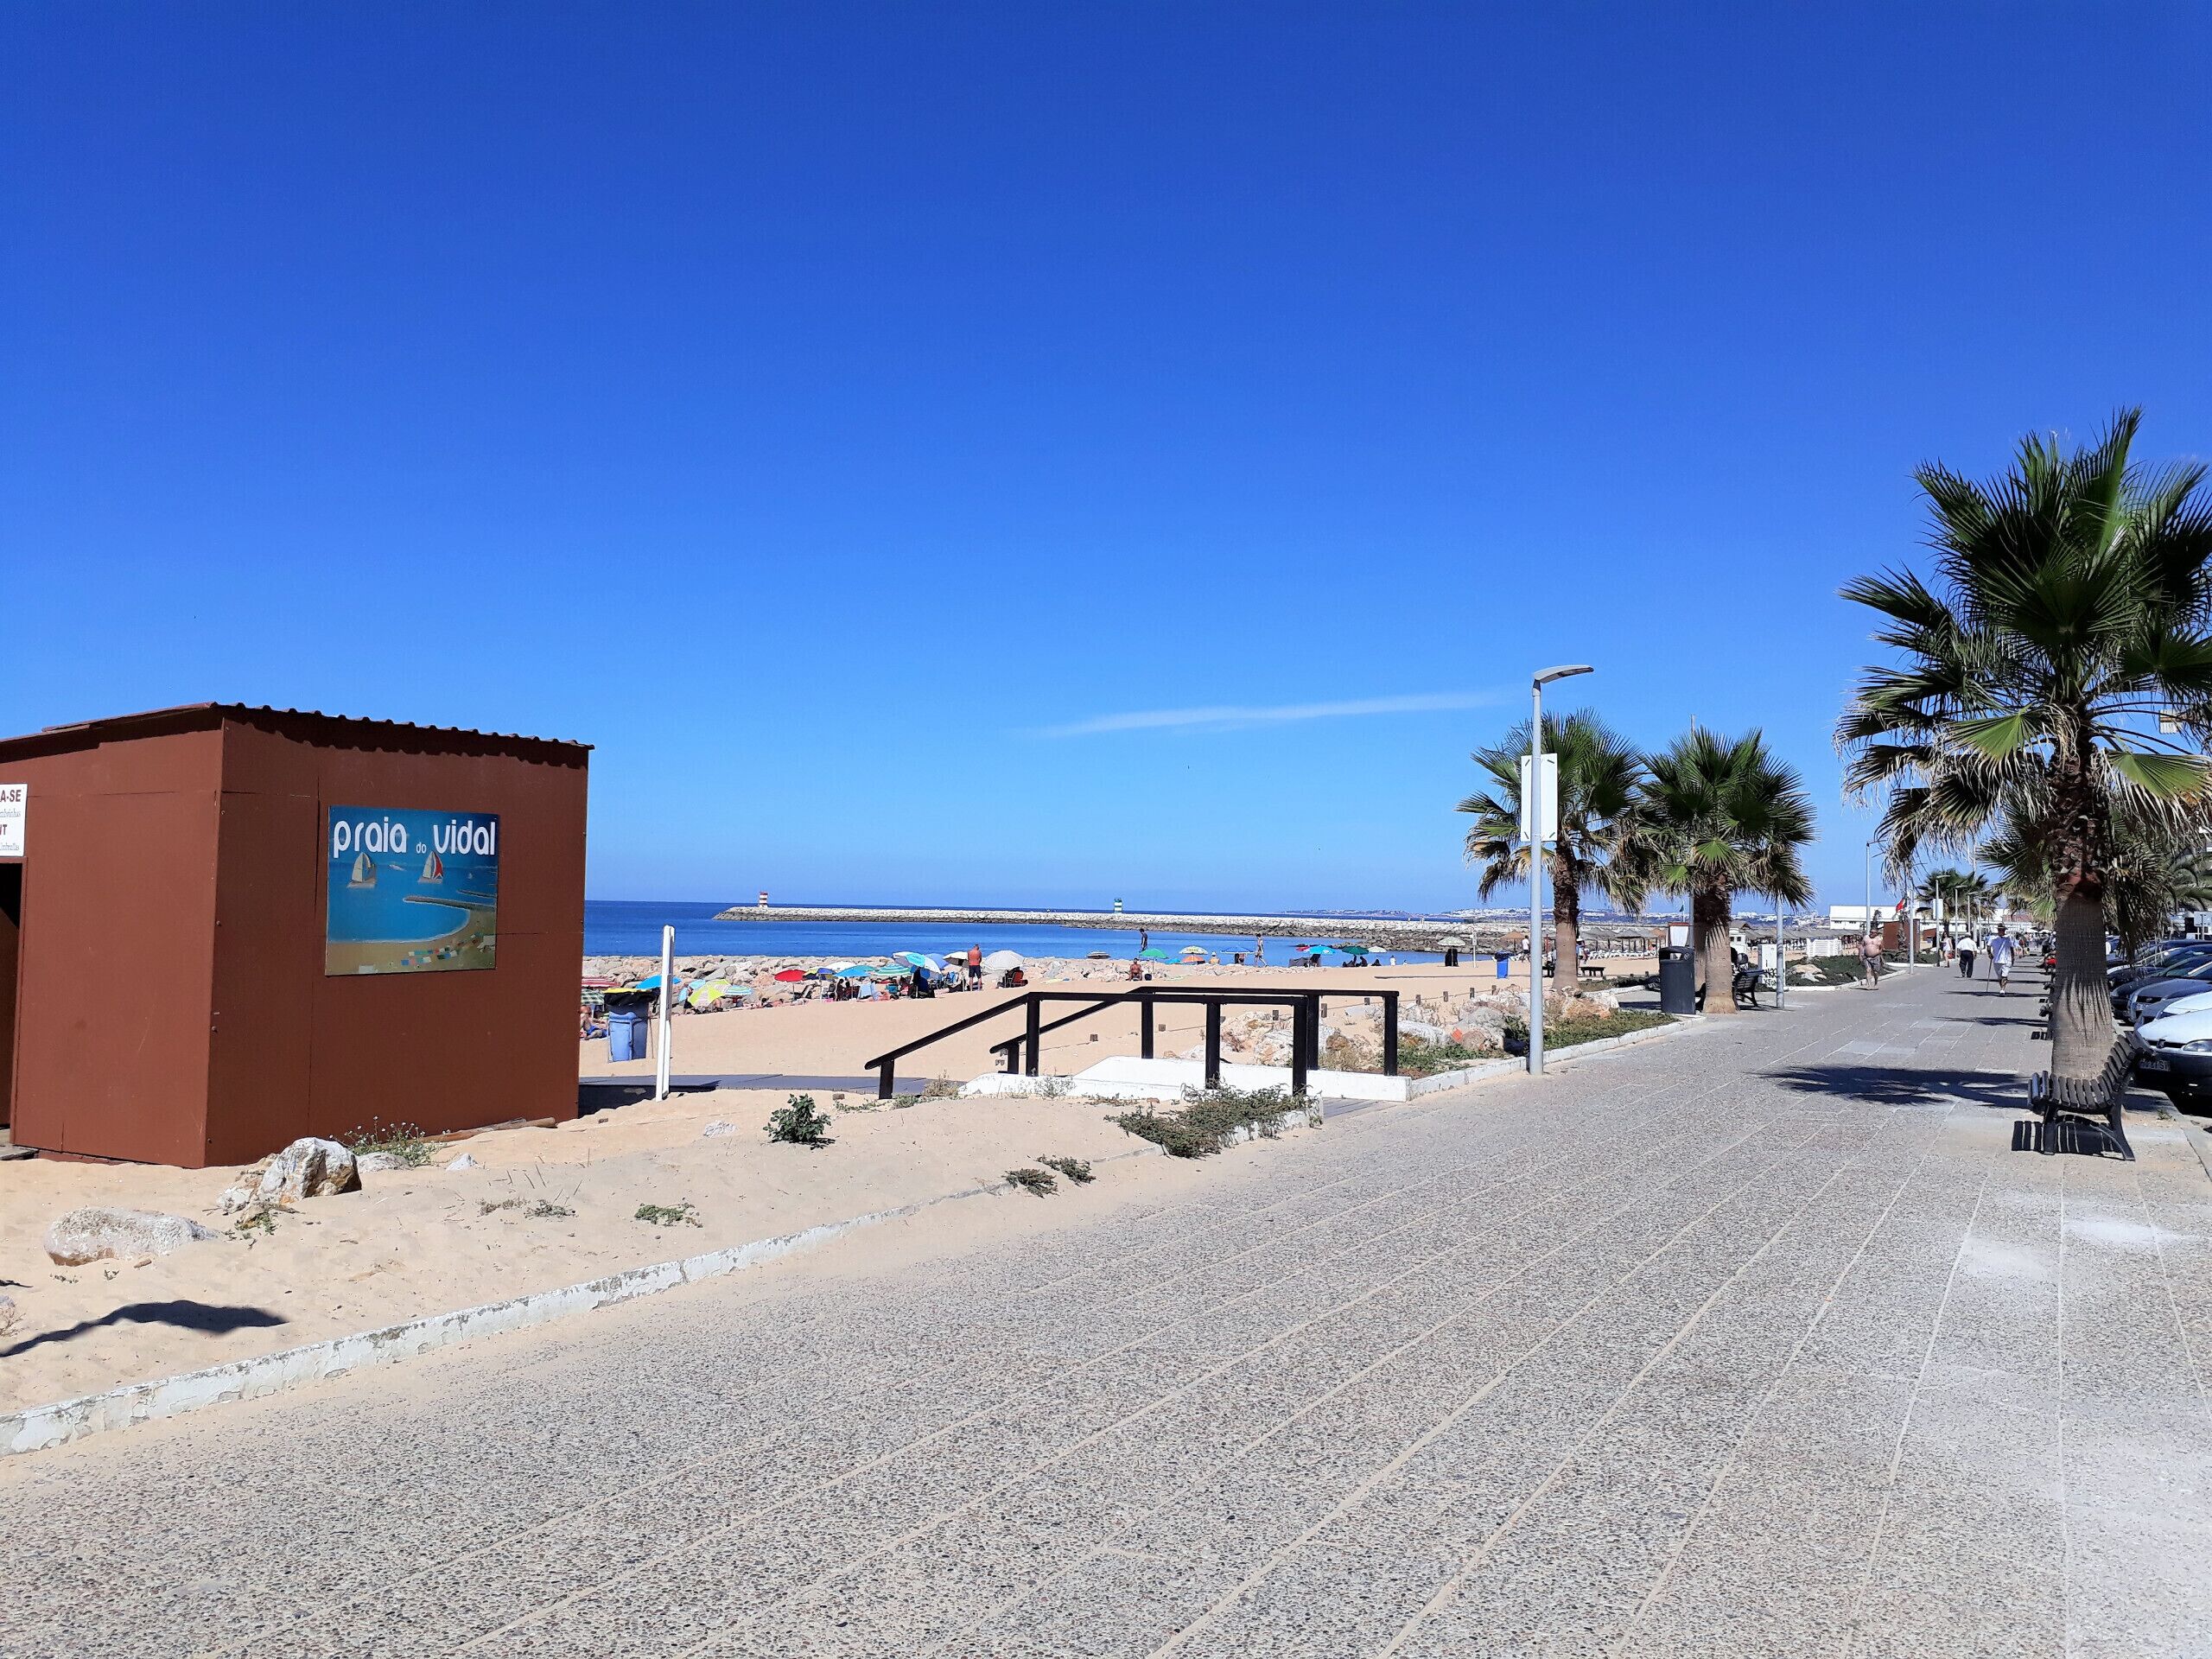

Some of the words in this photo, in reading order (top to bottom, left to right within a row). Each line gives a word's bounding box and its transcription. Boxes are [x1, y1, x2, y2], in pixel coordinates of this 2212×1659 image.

[0, 789, 22, 802] A-SE
[334, 817, 406, 858] praia
[416, 842, 427, 854] do
[433, 819, 495, 855] vidal
